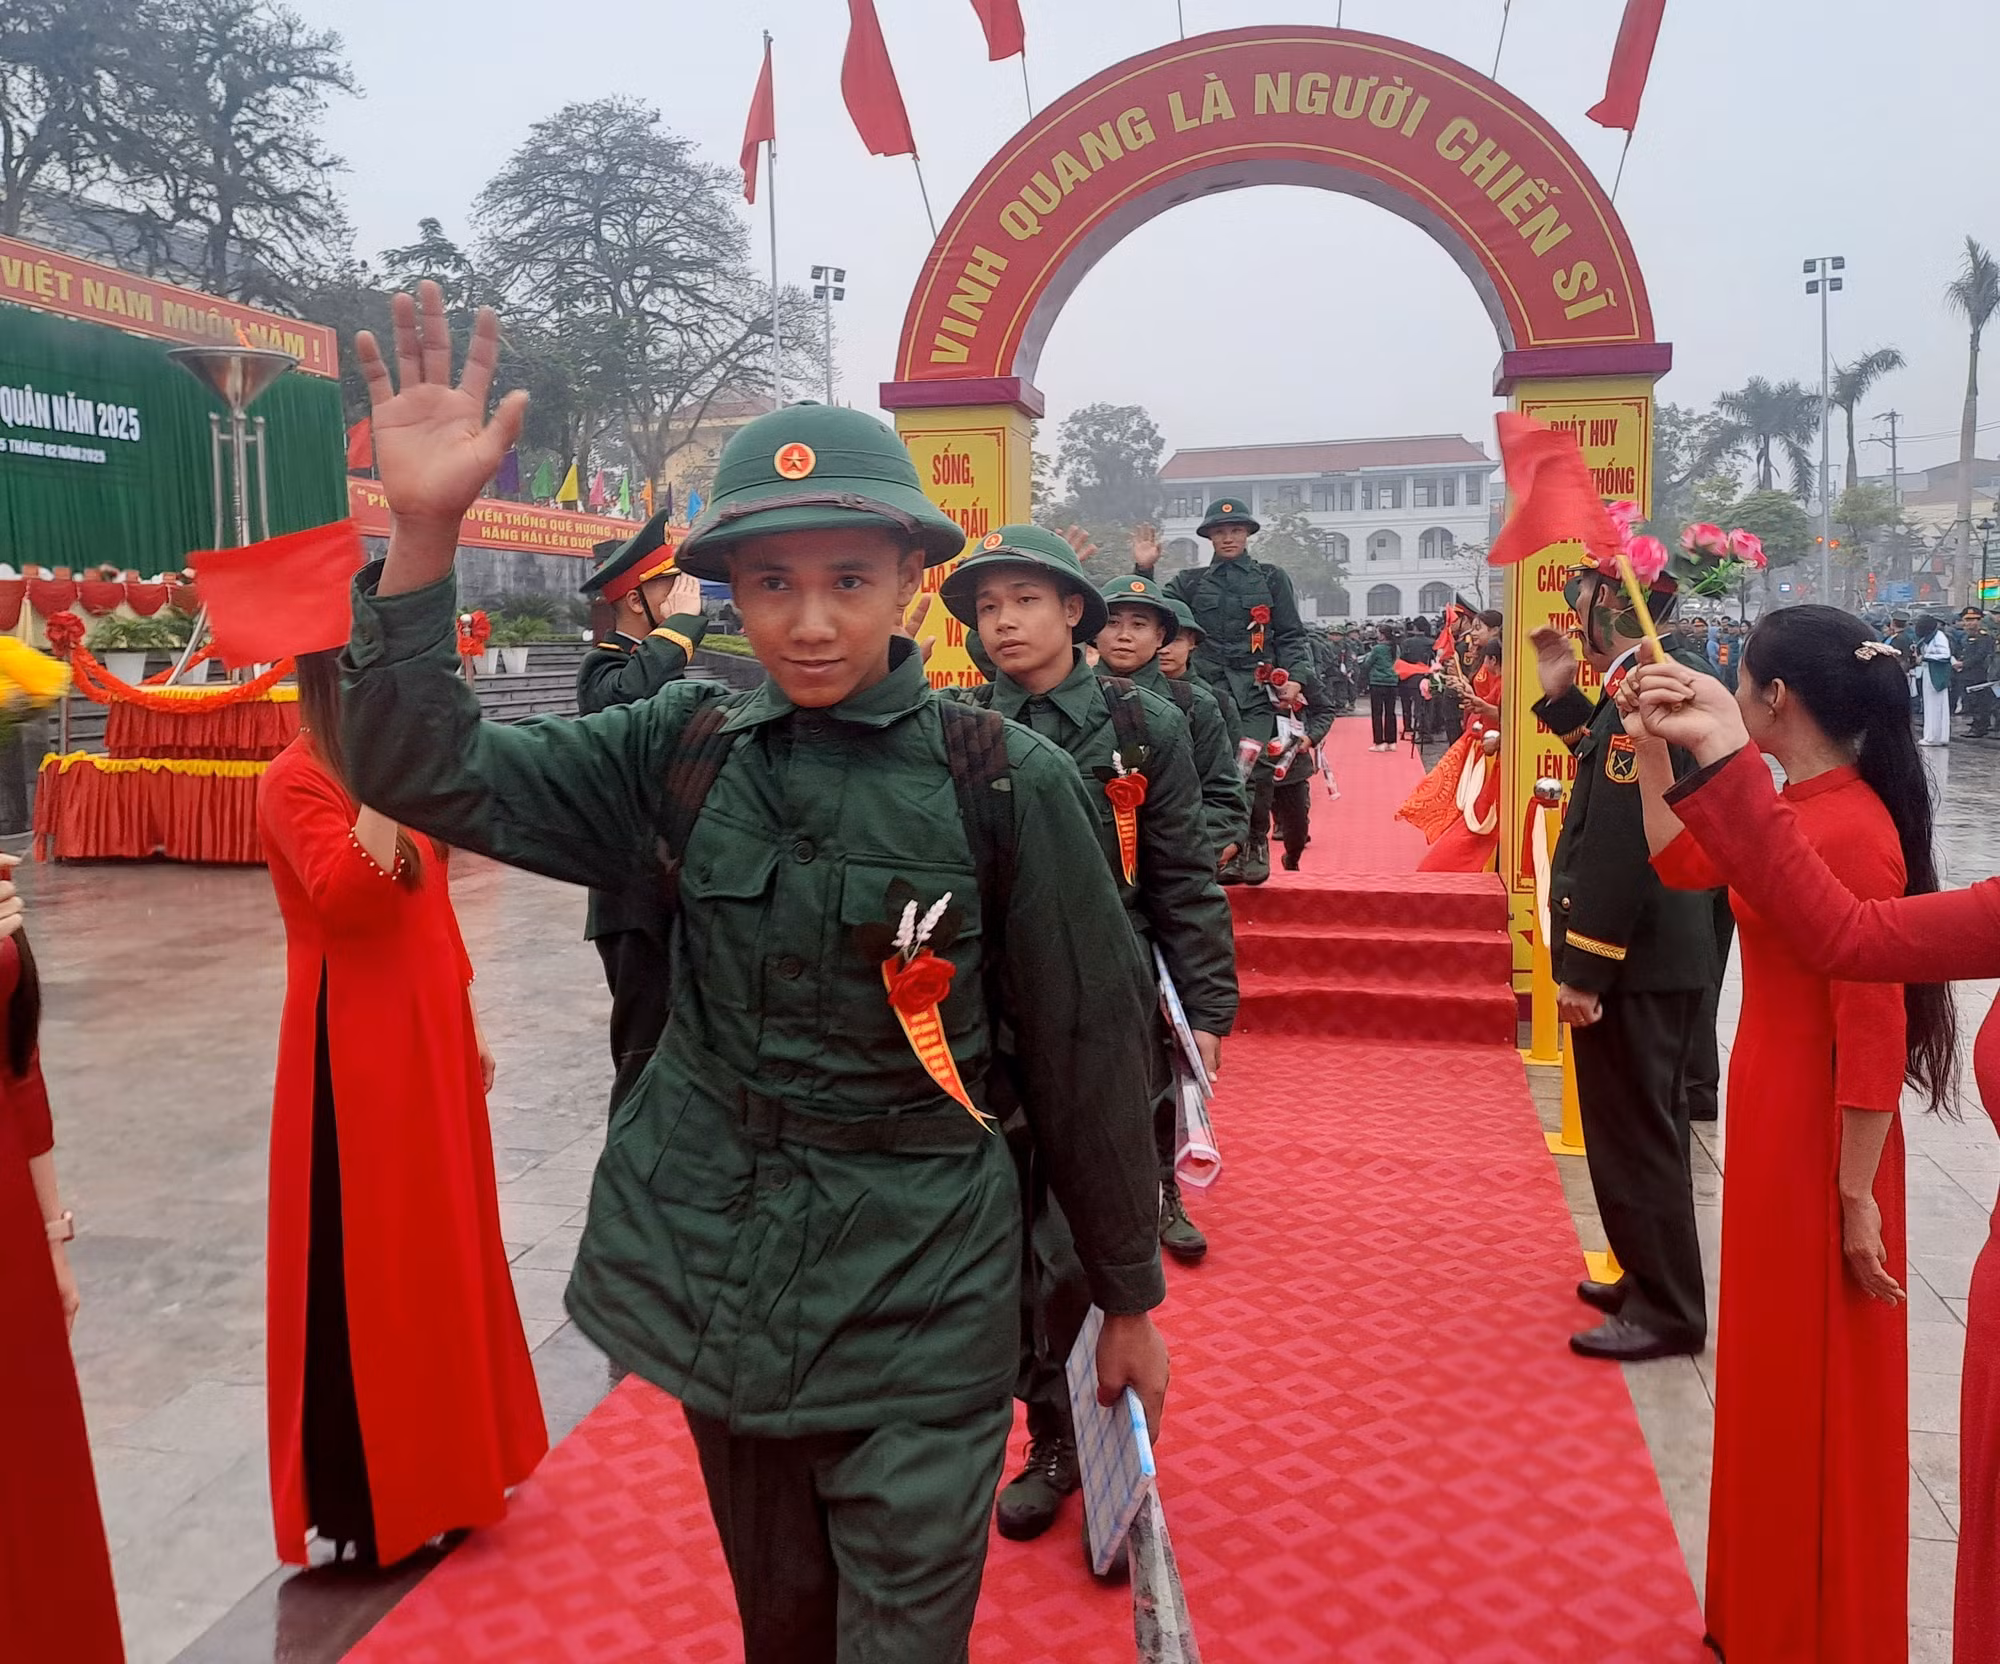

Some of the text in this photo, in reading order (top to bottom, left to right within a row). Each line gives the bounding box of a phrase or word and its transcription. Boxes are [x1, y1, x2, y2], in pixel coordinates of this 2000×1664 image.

[930, 71, 1618, 363] VINH QUANG LÀ NGƯỜI CHIẾN SĨ
[0, 255, 74, 303] VIỆT
[82, 277, 154, 322] NAM
[162, 301, 241, 342] MUÔN
[248, 321, 305, 360] NĂM
[0, 383, 140, 442] QUÂN NĂM 2025
[1589, 418, 1618, 447] HUY
[931, 442, 975, 488] SỐNG,
[1536, 748, 1563, 781] LÊN
